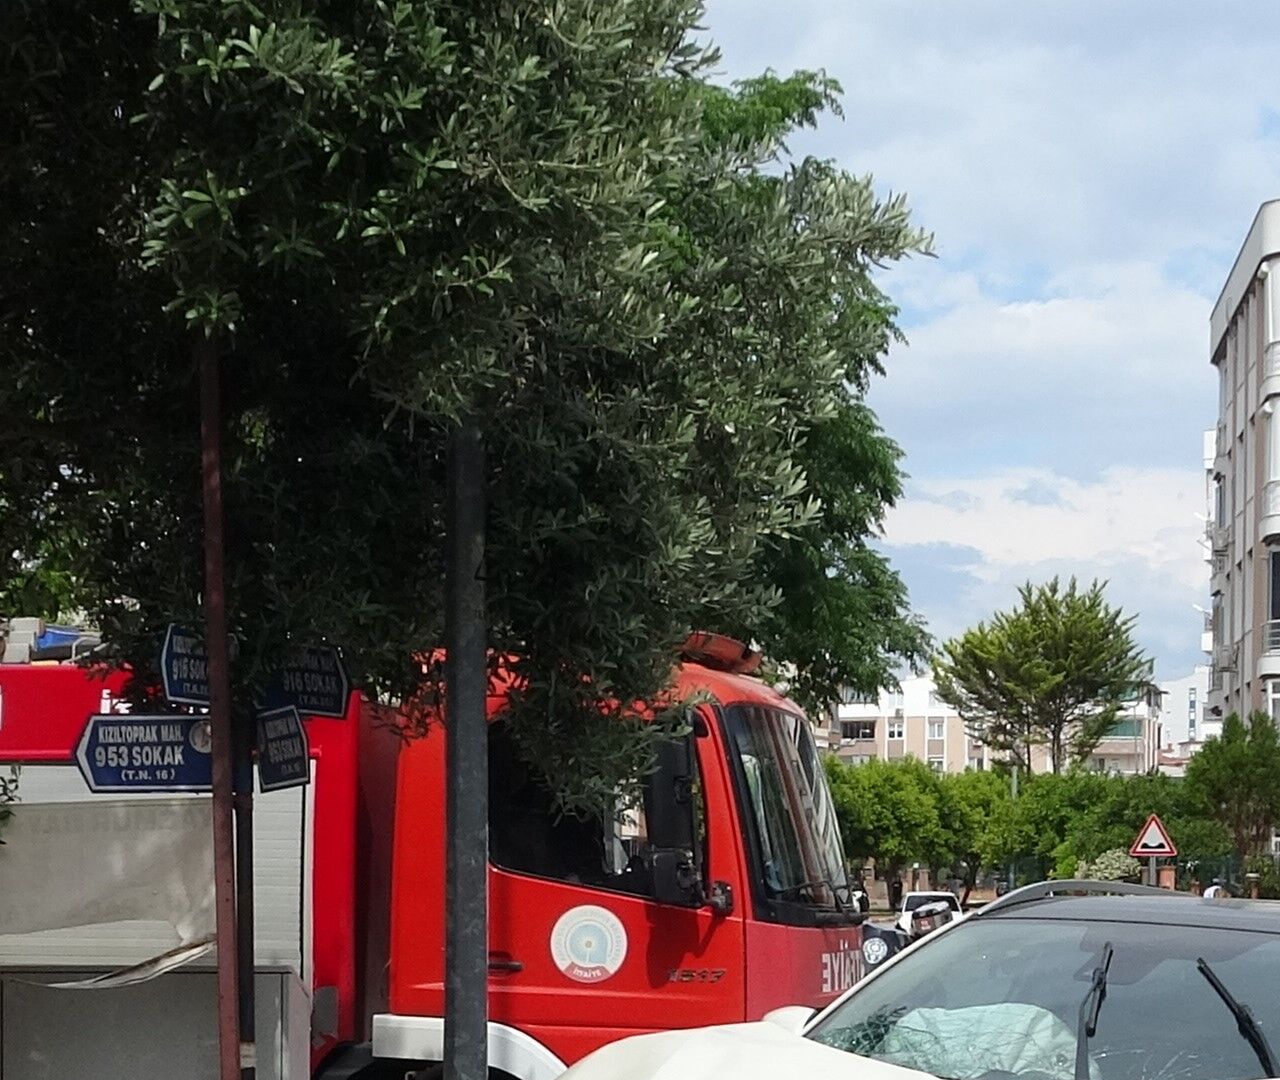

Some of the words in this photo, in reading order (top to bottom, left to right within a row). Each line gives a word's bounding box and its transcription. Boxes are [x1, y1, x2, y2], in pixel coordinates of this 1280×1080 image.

[99, 725, 158, 743] KIZILTOPRAK
[160, 725, 184, 742] MAH.
[95, 746, 128, 767] 953
[132, 745, 184, 767] SOKAK
